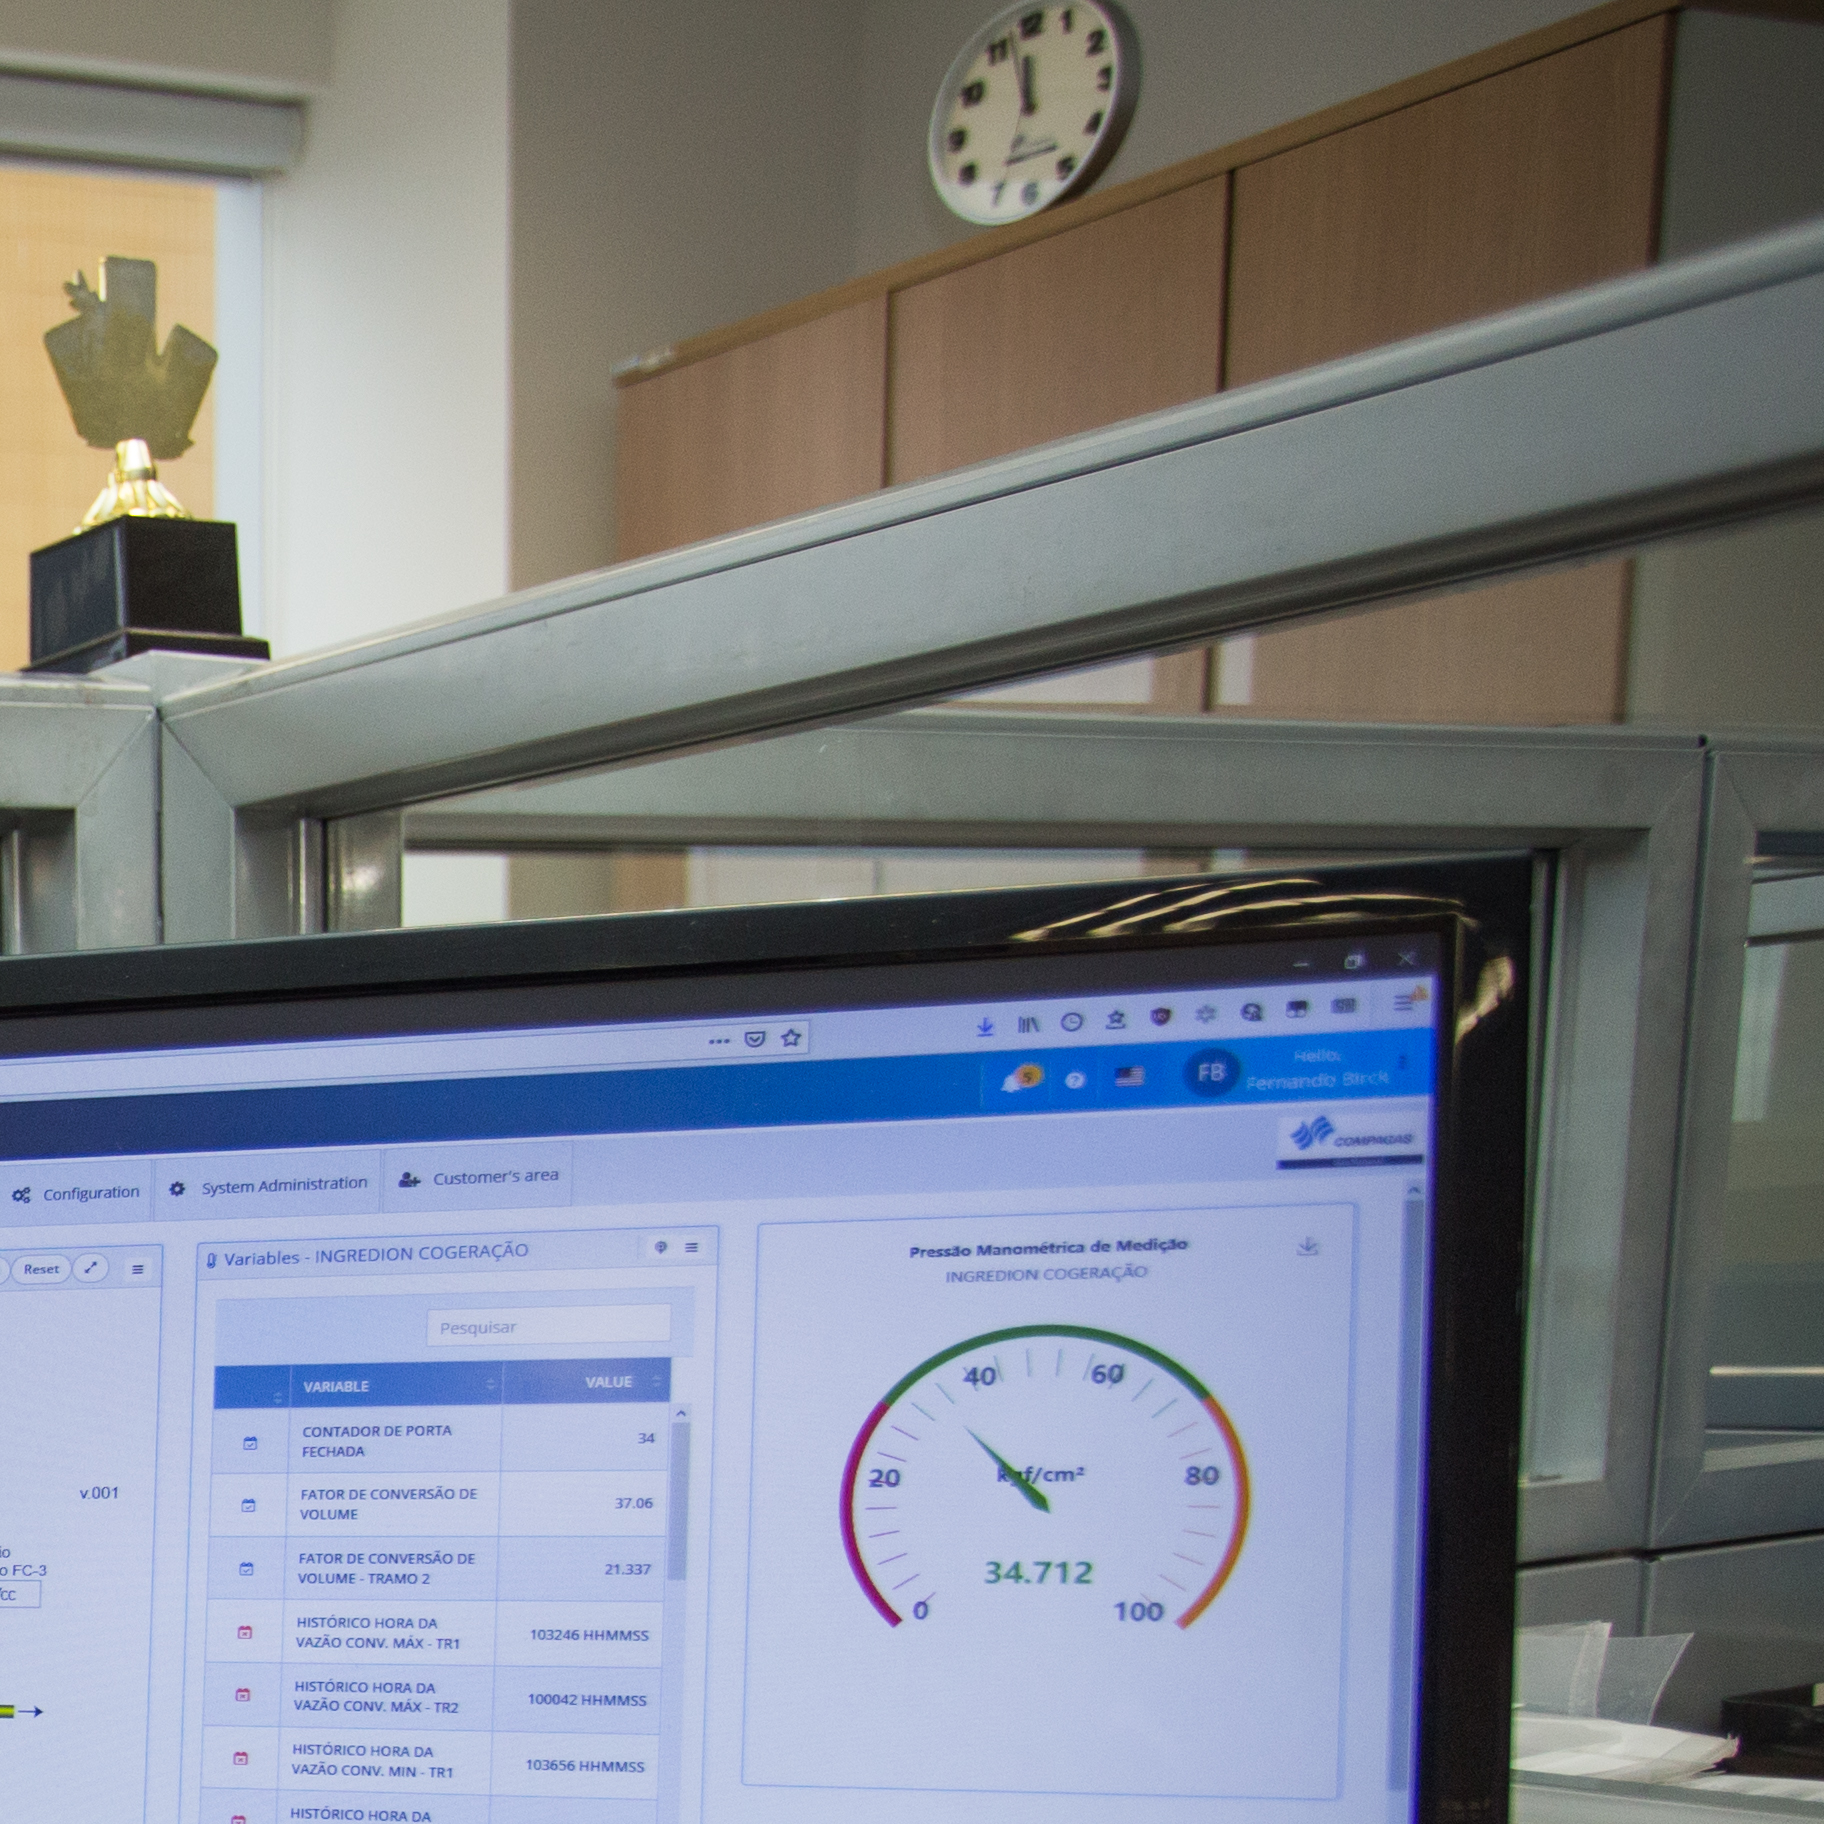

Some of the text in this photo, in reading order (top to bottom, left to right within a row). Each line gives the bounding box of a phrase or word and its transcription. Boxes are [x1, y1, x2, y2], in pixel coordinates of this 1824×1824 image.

[1197, 1062, 1226, 1081] FB
[525, 1169, 559, 1182] area
[202, 1174, 368, 1197] System Administration
[44, 1184, 140, 1206] Configuration
[224, 1241, 529, 1267] Variables INGREDION COGERAÇÃO
[910, 1238, 1188, 1258] Pressão Manométrica de Medição
[24, 1262, 60, 1276] Reset
[947, 1264, 1148, 1283] INGREDION COGERAÇÃO
[440, 1320, 517, 1337] Pesquisar
[586, 1376, 632, 1388] VALUE
[964, 1367, 996, 1386] 40
[1091, 1364, 1124, 1384] 60
[304, 1380, 369, 1393] VARIABLE
[303, 1424, 452, 1438] CONTADOR DE PORTA
[638, 1432, 655, 1444] 34
[302, 1446, 365, 1458] FECHADA
[869, 1469, 901, 1488] 20
[1184, 1466, 1220, 1486] 80
[80, 1487, 119, 1500] v.001
[301, 1485, 477, 1501] FATOR DE CONVERSÃO DE
[615, 1497, 653, 1509] 37.06
[300, 1508, 358, 1520] VOLUME
[12, 1563, 46, 1577] FC-3
[985, 1561, 1093, 1585] 34.712
[1114, 1602, 1164, 1622] 100
